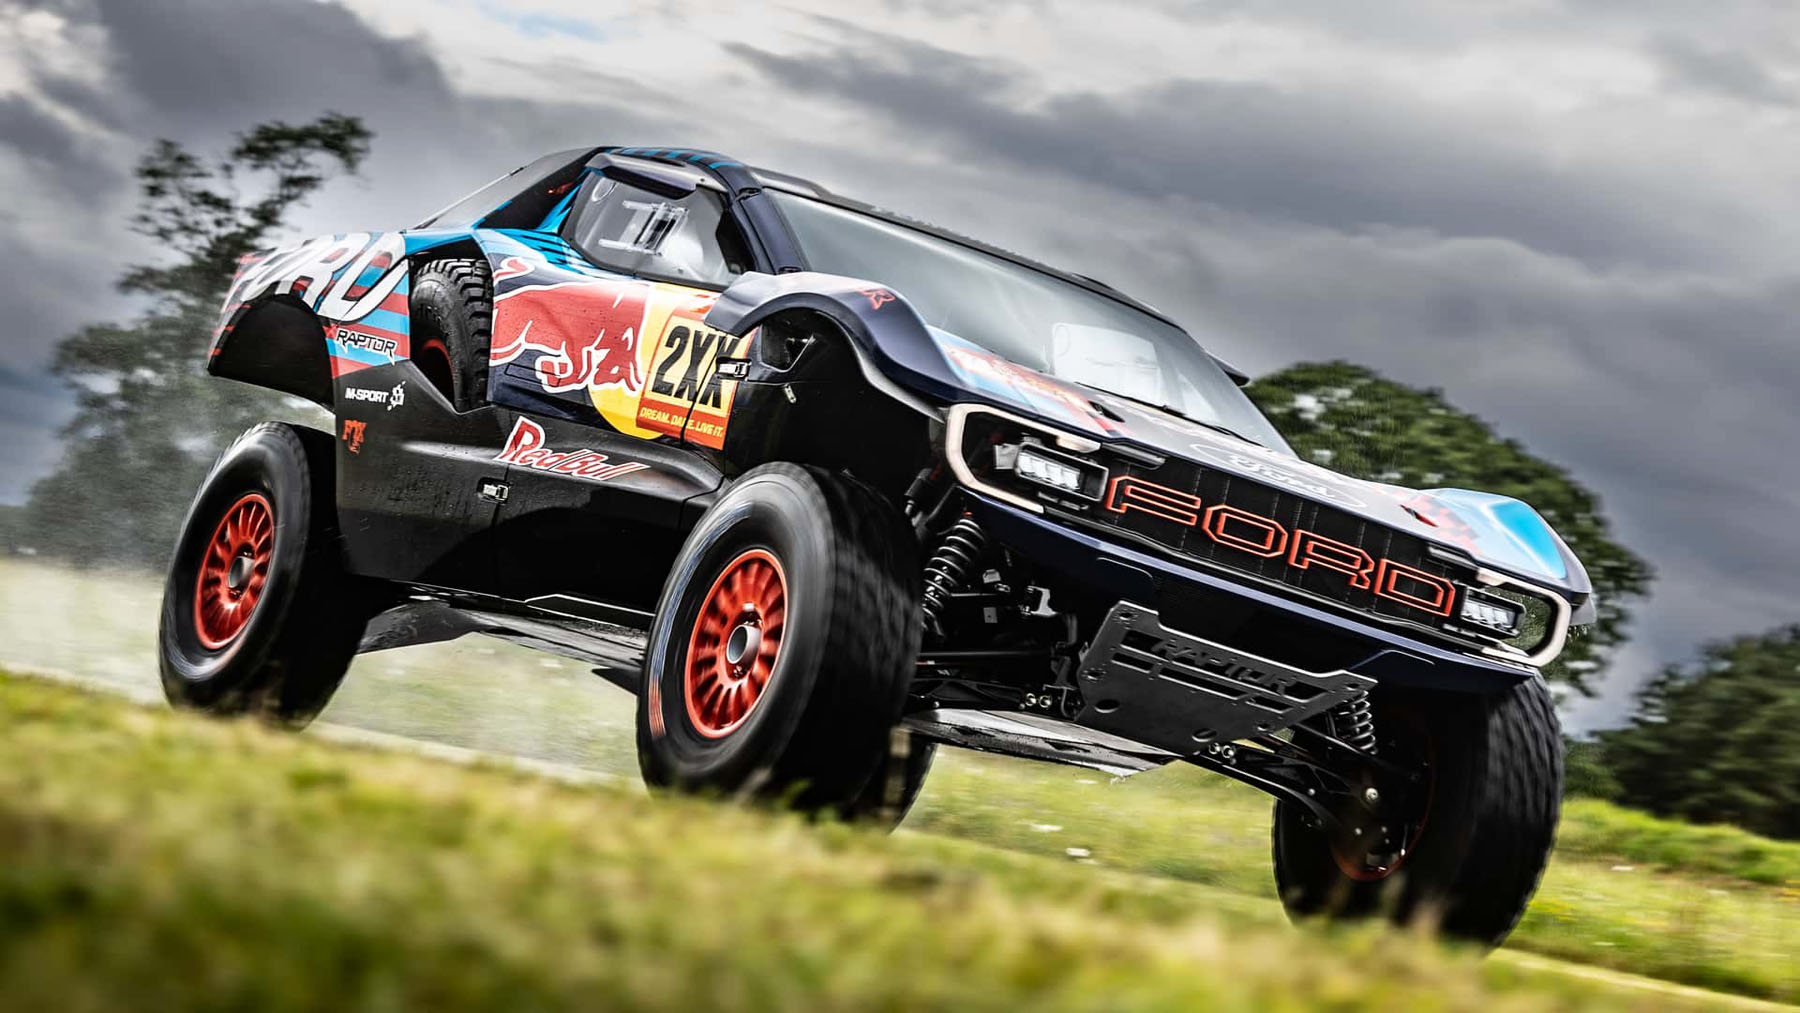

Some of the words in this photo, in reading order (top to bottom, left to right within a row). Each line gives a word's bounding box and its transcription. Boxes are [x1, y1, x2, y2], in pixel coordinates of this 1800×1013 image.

[336, 329, 397, 364] RAPTOR
[652, 325, 740, 409] 2XX
[345, 387, 389, 403] M-SPORT
[640, 407, 670, 423] DREAM.
[695, 420, 714, 435] LIVE
[1106, 474, 1455, 617] FORD
